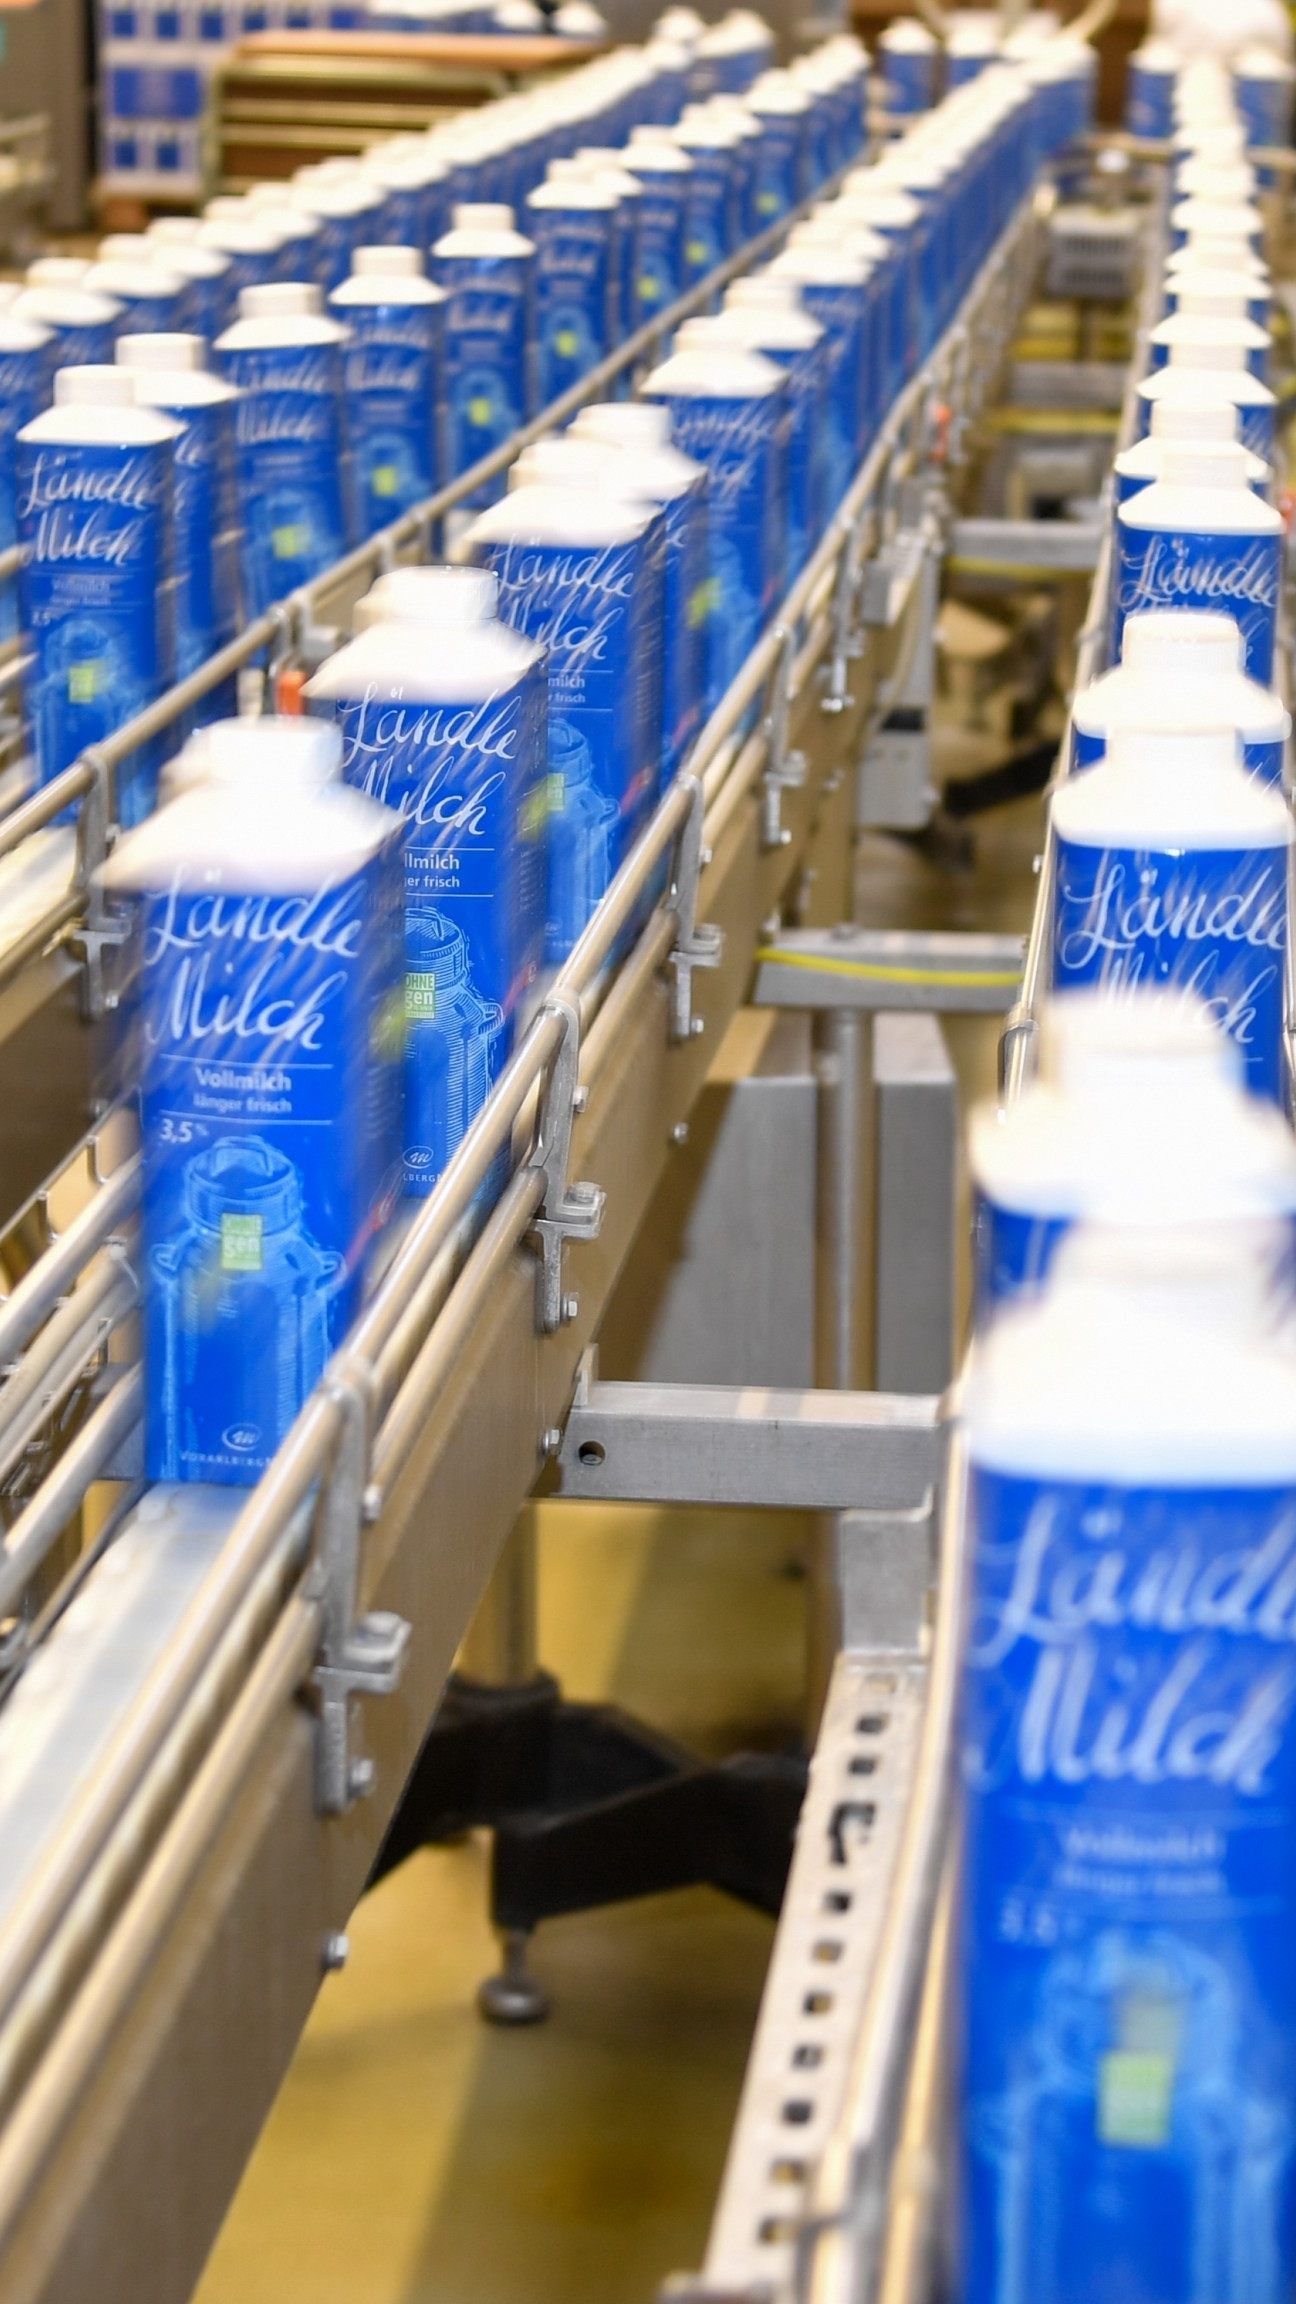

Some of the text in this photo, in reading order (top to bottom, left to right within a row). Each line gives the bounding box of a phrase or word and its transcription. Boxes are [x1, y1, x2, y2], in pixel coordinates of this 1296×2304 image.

[493, 533, 637, 598] Ländle
[548, 675, 585, 688] milch
[337, 682, 522, 769] Ländle
[361, 756, 506, 834] Milch
[404, 853, 460, 870] llmilch
[424, 875, 460, 888] frisch
[145, 863, 367, 965] Ländle
[145, 952, 349, 1051] Milch
[194, 1066, 292, 1092] Vollmilch
